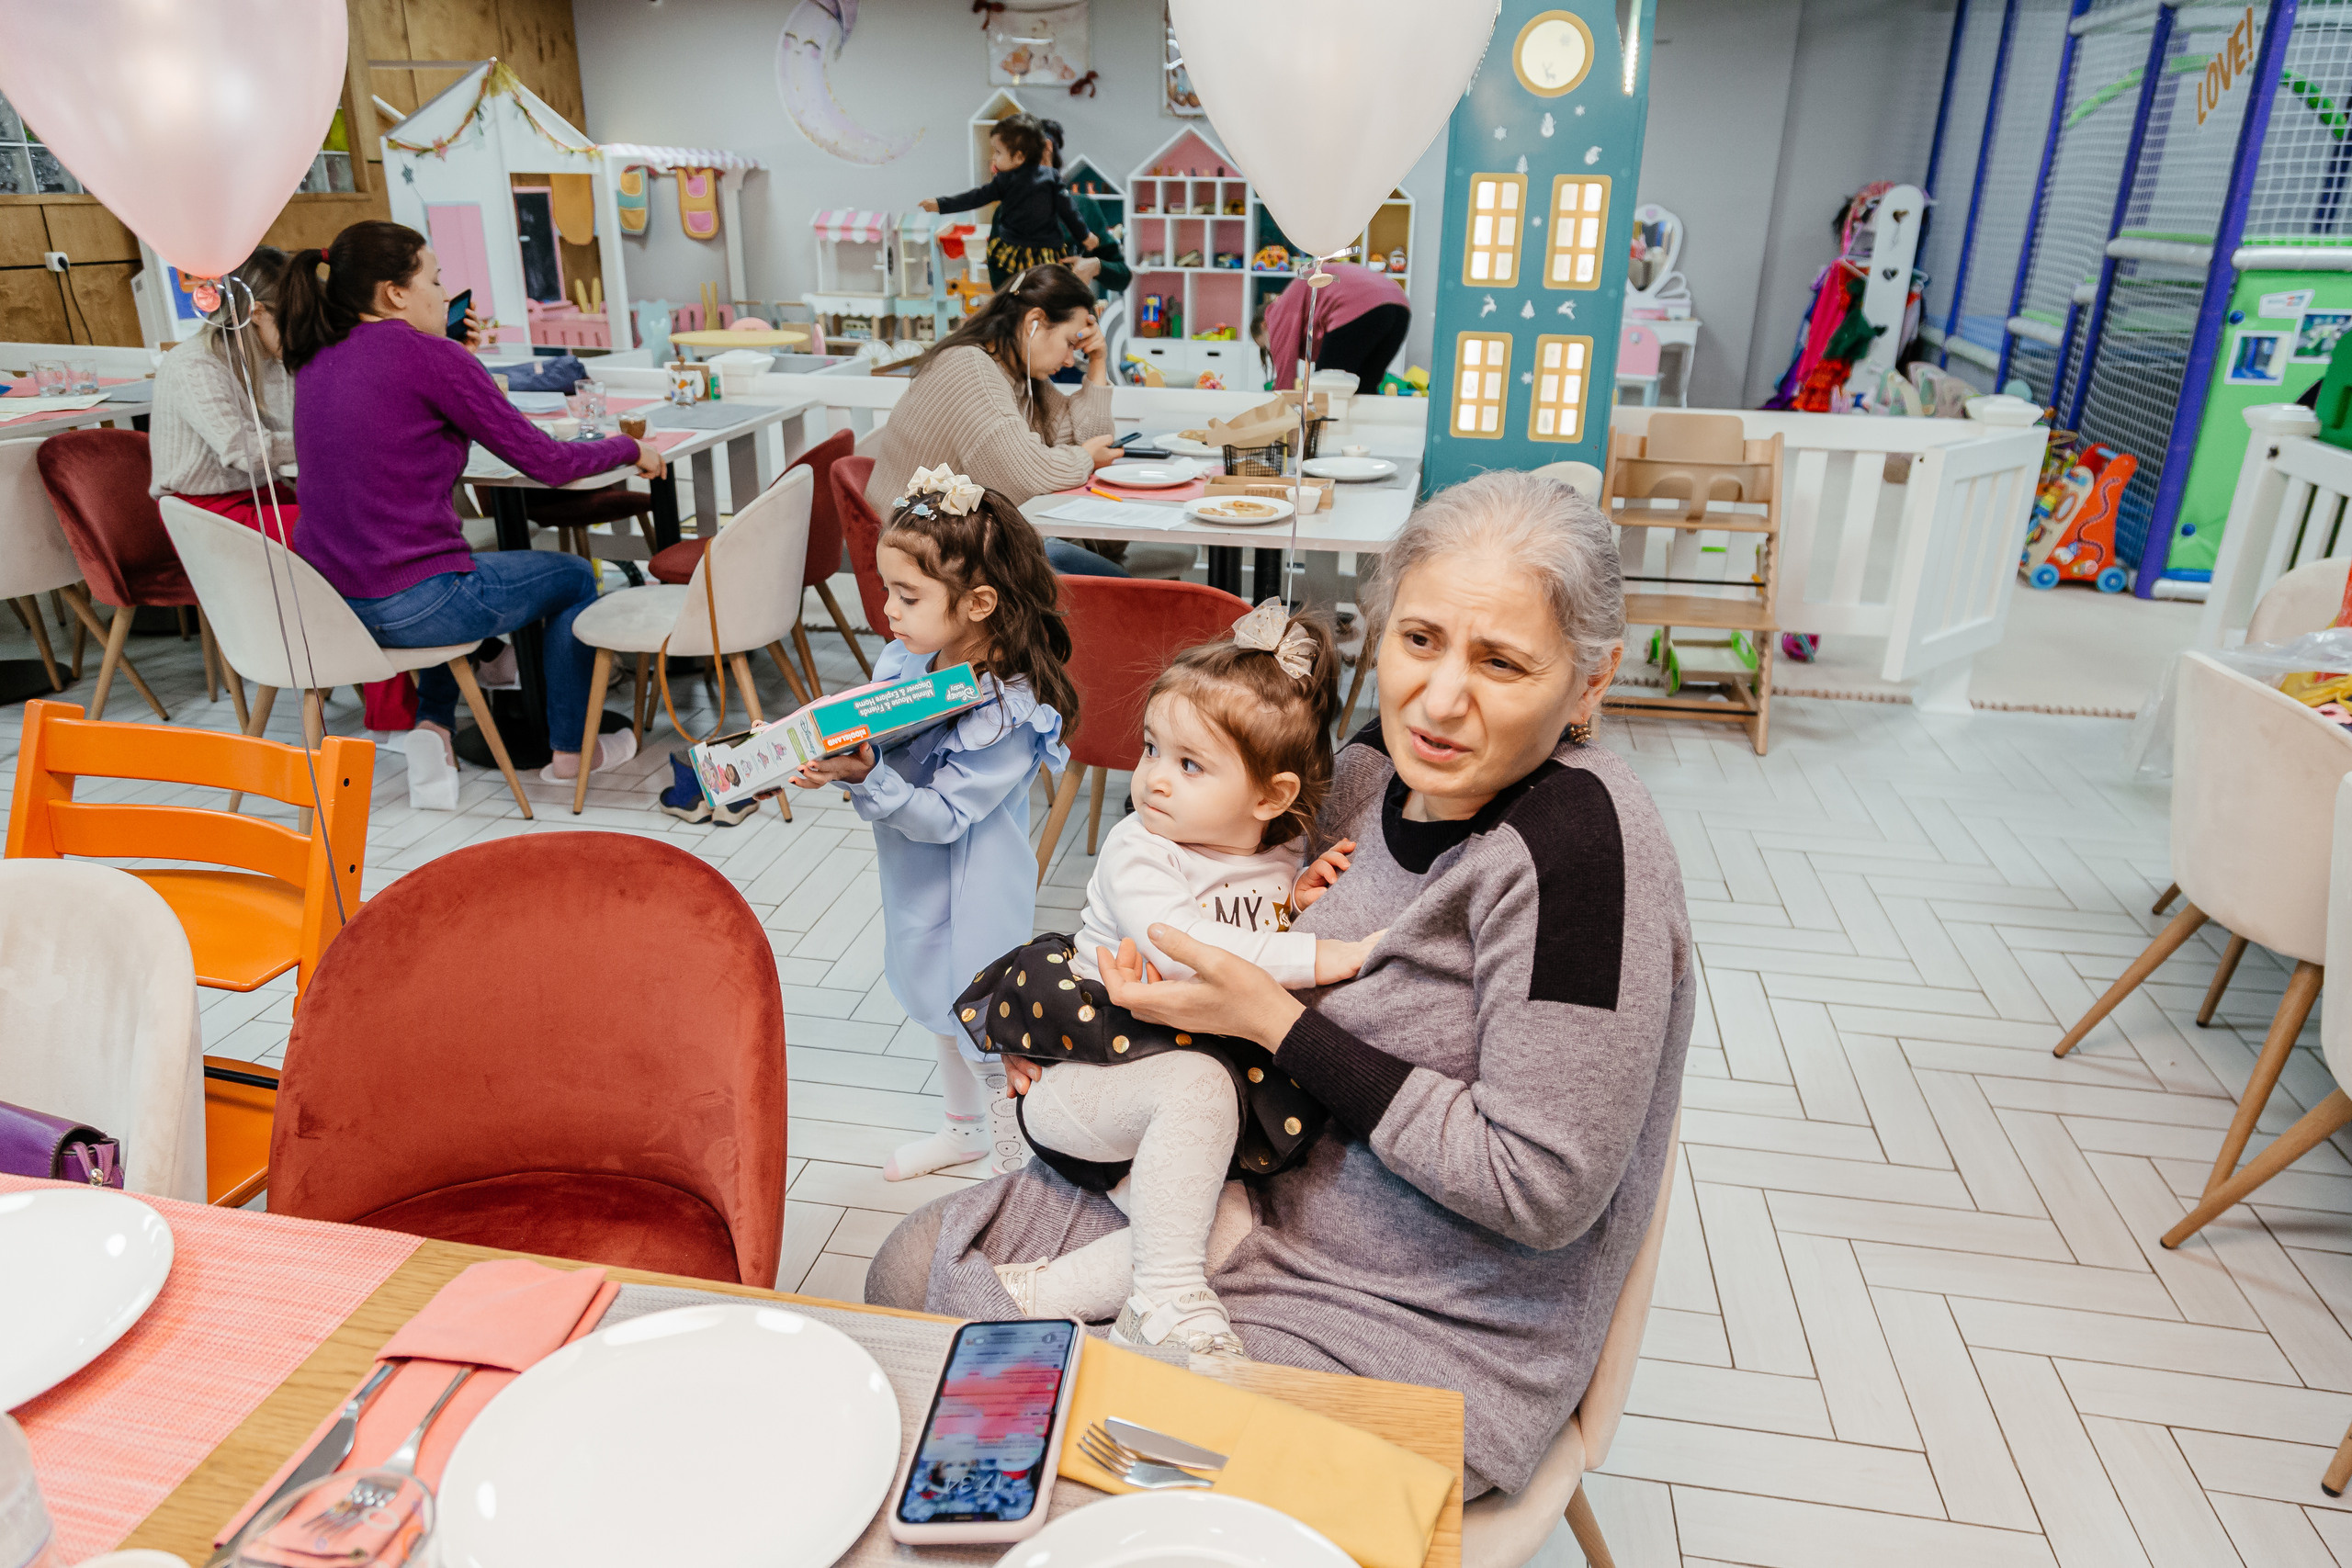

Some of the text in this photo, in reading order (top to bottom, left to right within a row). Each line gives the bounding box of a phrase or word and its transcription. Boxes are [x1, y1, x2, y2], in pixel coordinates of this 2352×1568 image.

[2198, 7, 2254, 125] LOVE!
[854, 681, 933, 708] Discover & Explore Home
[950, 683, 965, 692] baby
[859, 689, 934, 716] Minnie Mouse & Friends
[1215, 896, 1263, 932] MY
